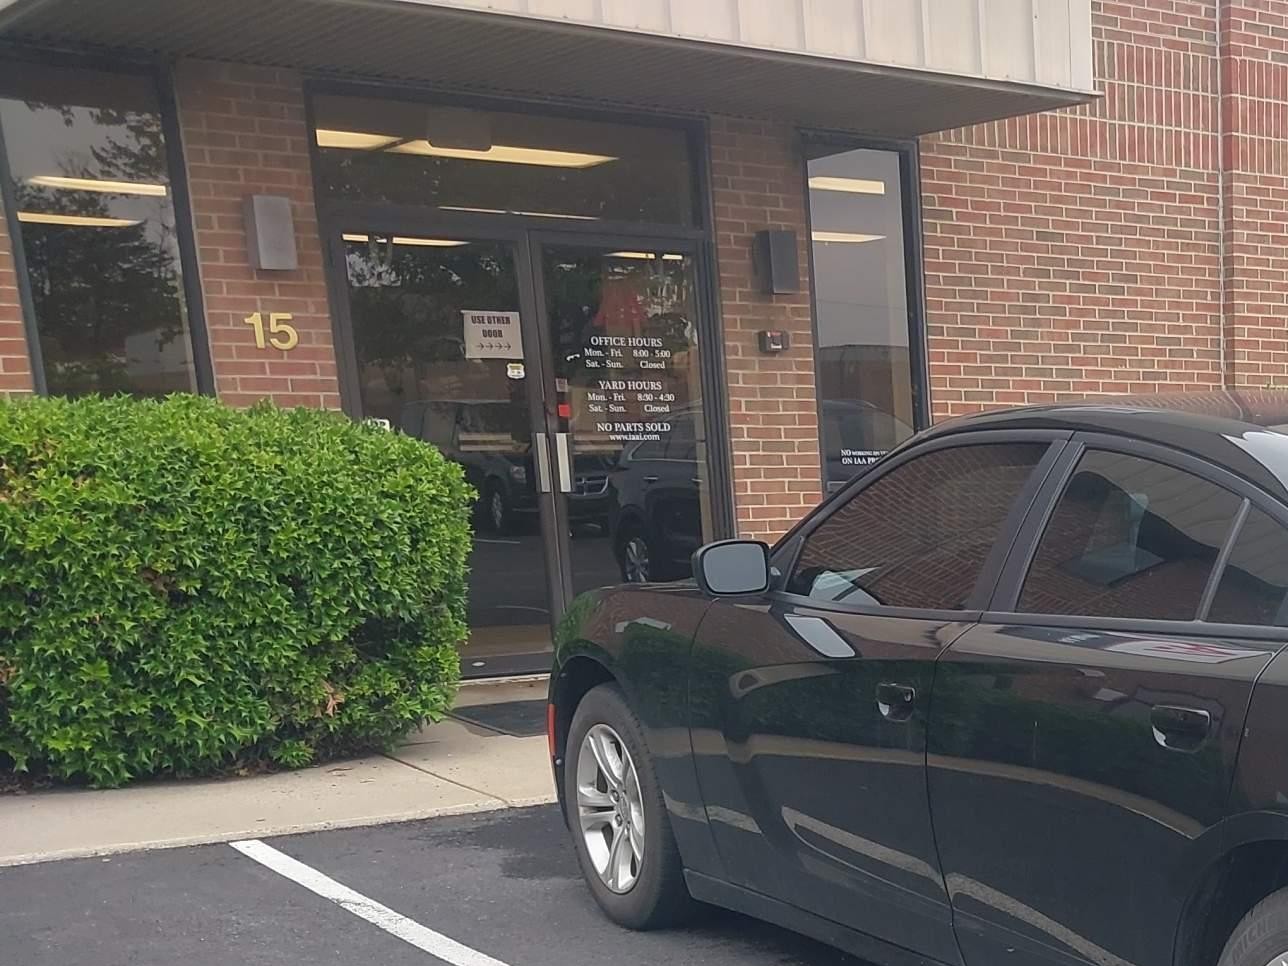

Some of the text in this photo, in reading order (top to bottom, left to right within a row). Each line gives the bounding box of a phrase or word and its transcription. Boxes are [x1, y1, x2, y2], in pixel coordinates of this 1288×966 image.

[471, 315, 511, 324] USE OTHER
[244, 312, 298, 350] 15
[482, 329, 503, 338] DOOR
[590, 336, 663, 347] OFFICE HOURS
[584, 348, 604, 357] Mon.
[610, 349, 623, 357] Fri.
[633, 350, 649, 358] 8:00
[586, 360, 600, 368] Sat.
[606, 360, 624, 368] Sun.
[640, 361, 666, 369] Closed
[599, 381, 662, 391] YARD HOURS
[587, 392, 608, 401] Mon.
[613, 393, 626, 401] Fri.
[589, 404, 603, 413] Sat.
[609, 404, 626, 413] Sun.
[644, 404, 670, 413] Closed
[597, 422, 671, 432] NO PARTS SOLD
[609, 433, 661, 441] www.iaai.com
